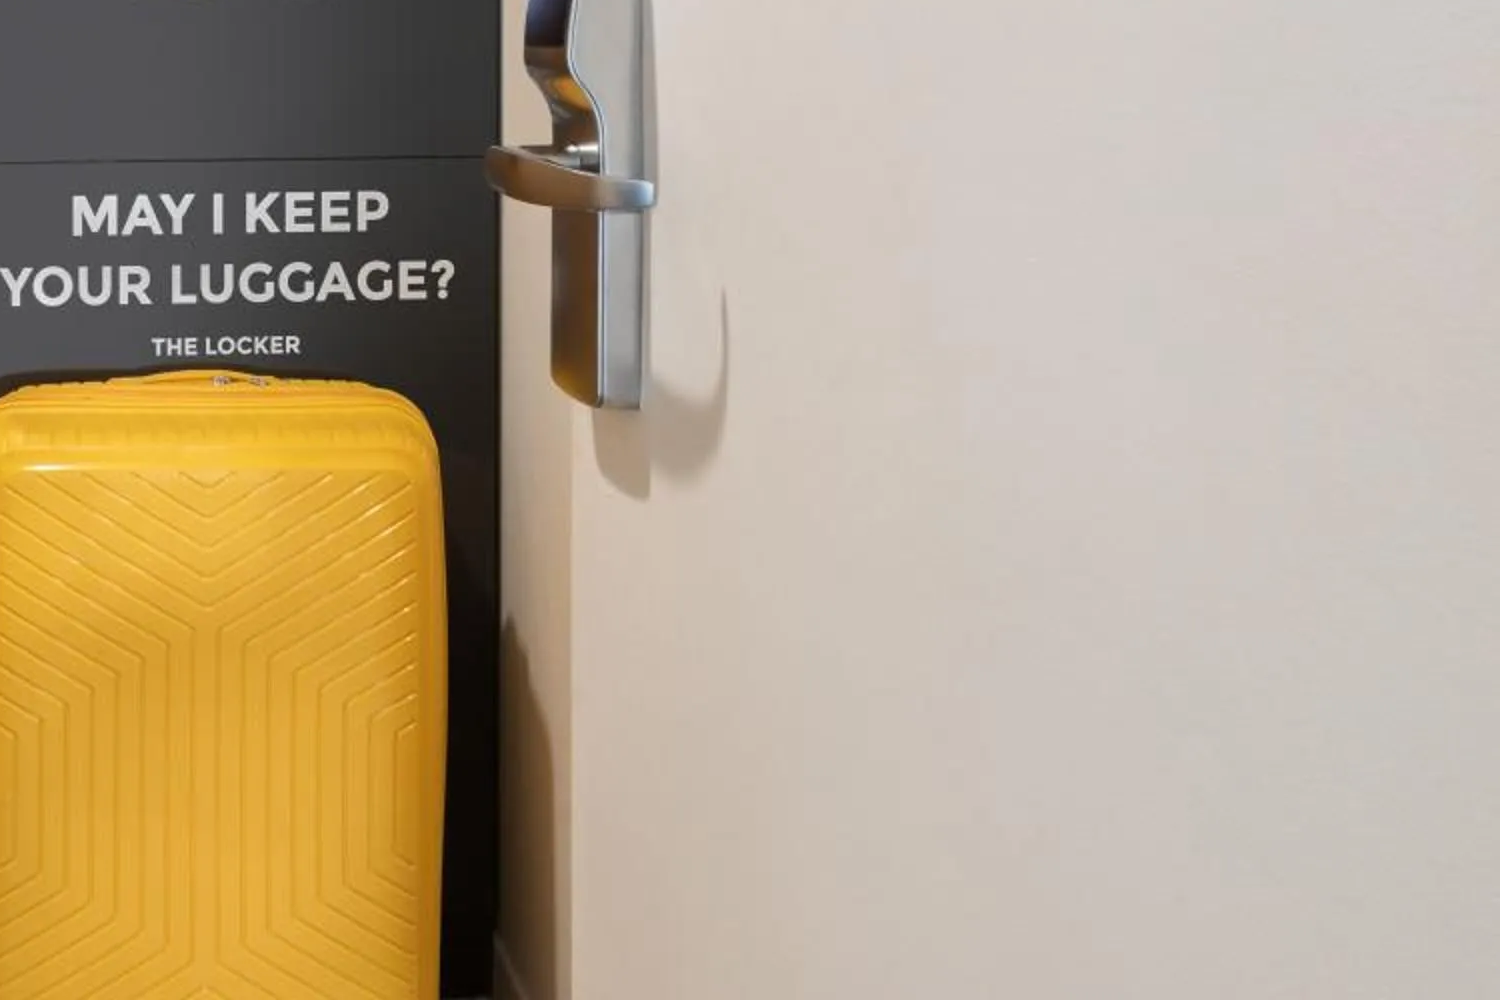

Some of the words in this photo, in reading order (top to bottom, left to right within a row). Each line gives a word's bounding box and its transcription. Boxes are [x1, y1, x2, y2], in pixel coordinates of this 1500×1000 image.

[71, 193, 196, 237] MAY
[212, 192, 224, 235] I
[245, 190, 389, 234] KEEP
[171, 258, 456, 305] LUGGAGE?
[151, 336, 198, 357] THE
[205, 335, 301, 356] LOCKER
